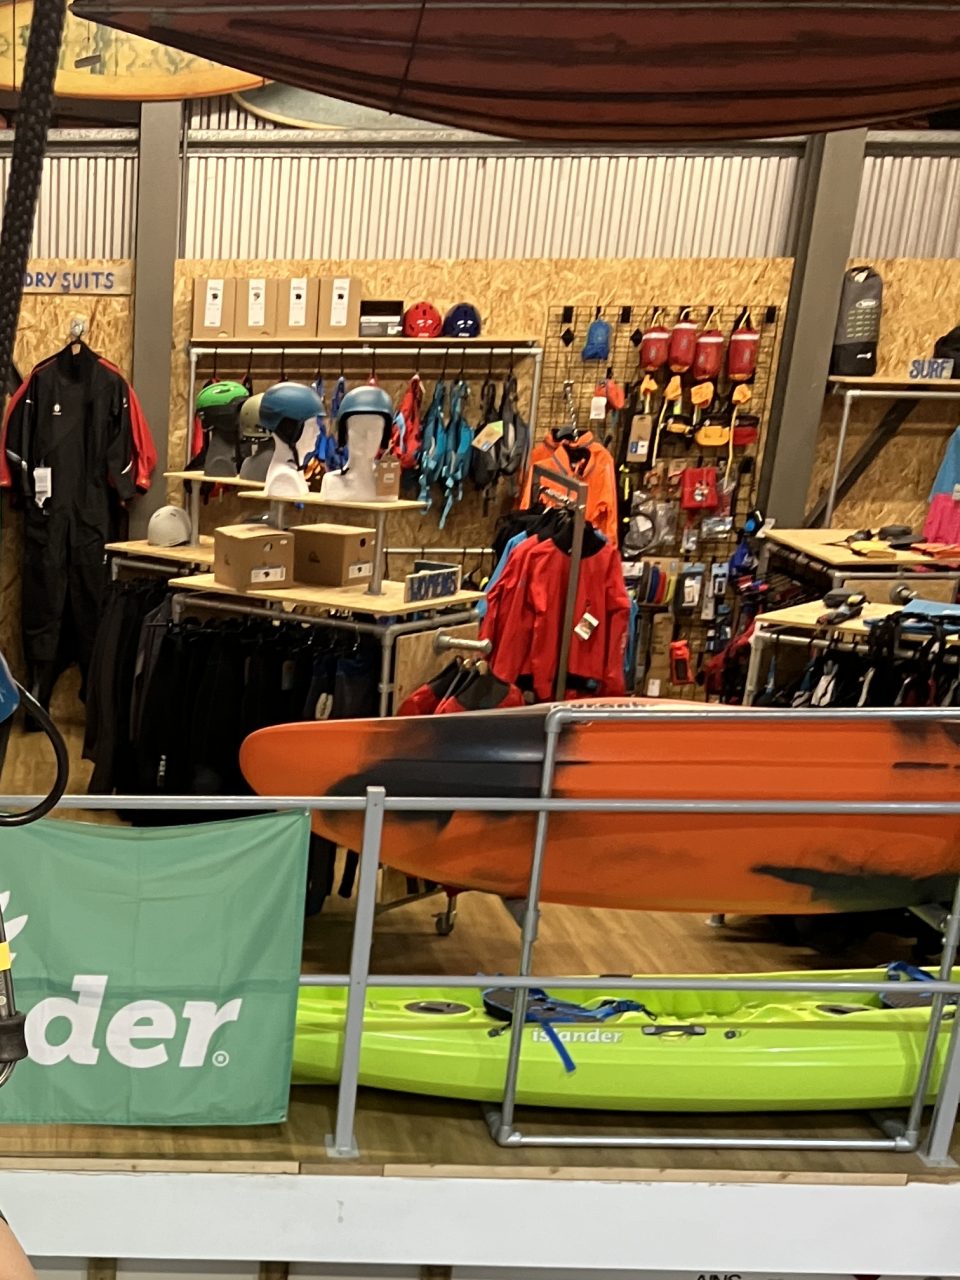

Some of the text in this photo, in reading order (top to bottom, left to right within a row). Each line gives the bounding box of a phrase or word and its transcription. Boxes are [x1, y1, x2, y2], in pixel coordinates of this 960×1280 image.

[23, 271, 114, 290] DRY SUITS
[909, 359, 948, 379] SURF
[532, 1026, 623, 1043] isander
